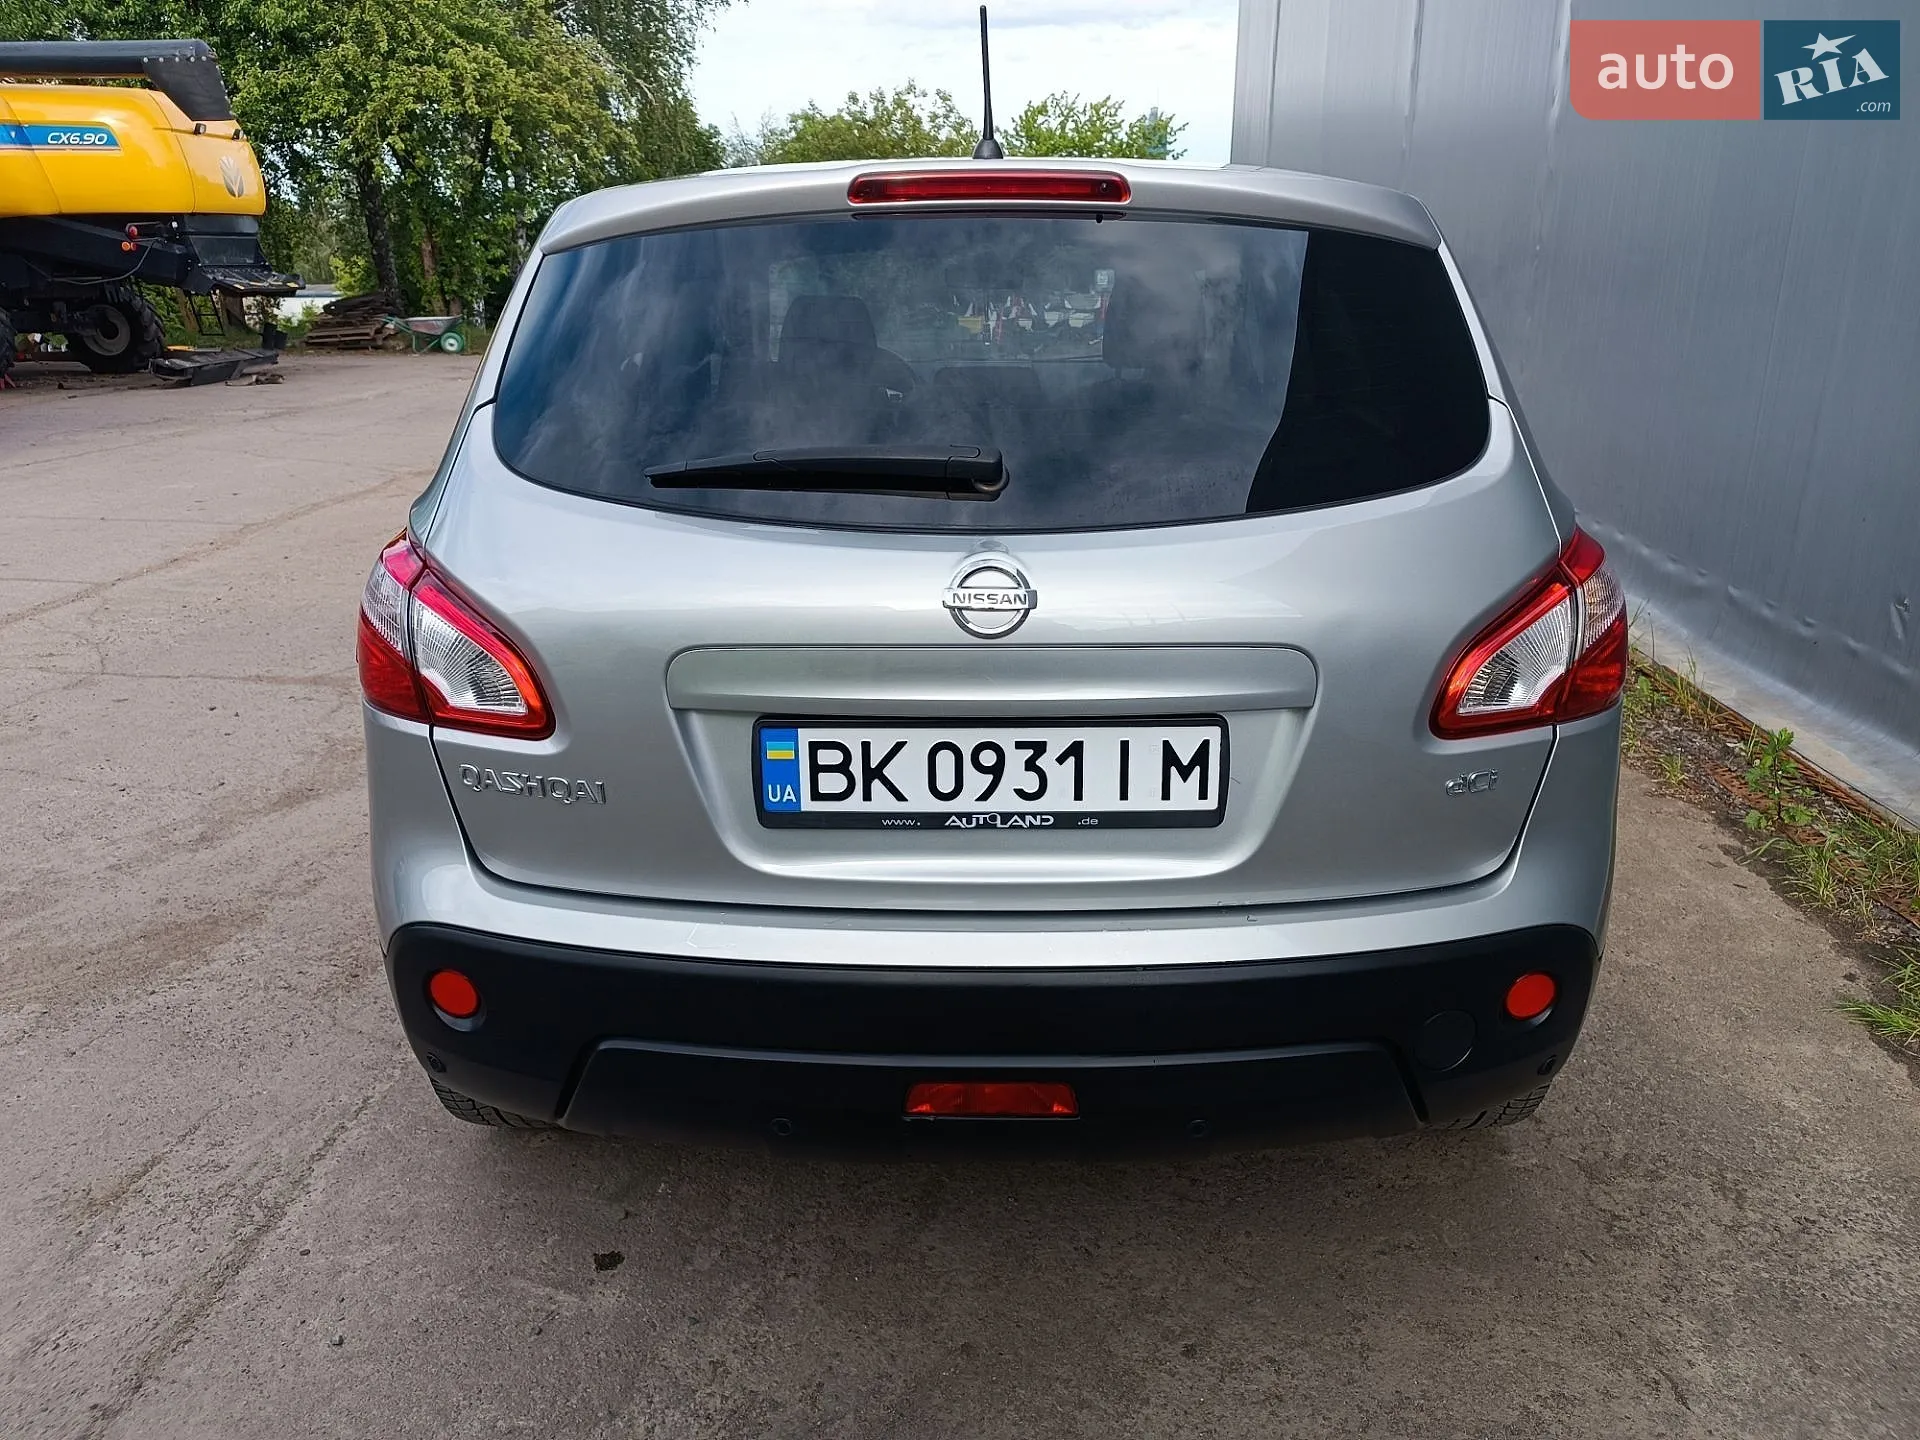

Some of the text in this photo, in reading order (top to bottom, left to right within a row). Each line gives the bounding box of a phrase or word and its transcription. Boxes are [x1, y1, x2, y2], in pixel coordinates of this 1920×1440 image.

[47, 132, 108, 145] CX6.90
[952, 592, 1027, 605] NISSAN
[808, 740, 909, 802] BK
[927, 740, 1084, 801] 0931
[459, 763, 607, 804] QASHQAI
[1445, 768, 1498, 796] dCi
[767, 785, 797, 803] UA
[944, 812, 1055, 828] AUTOLAND
